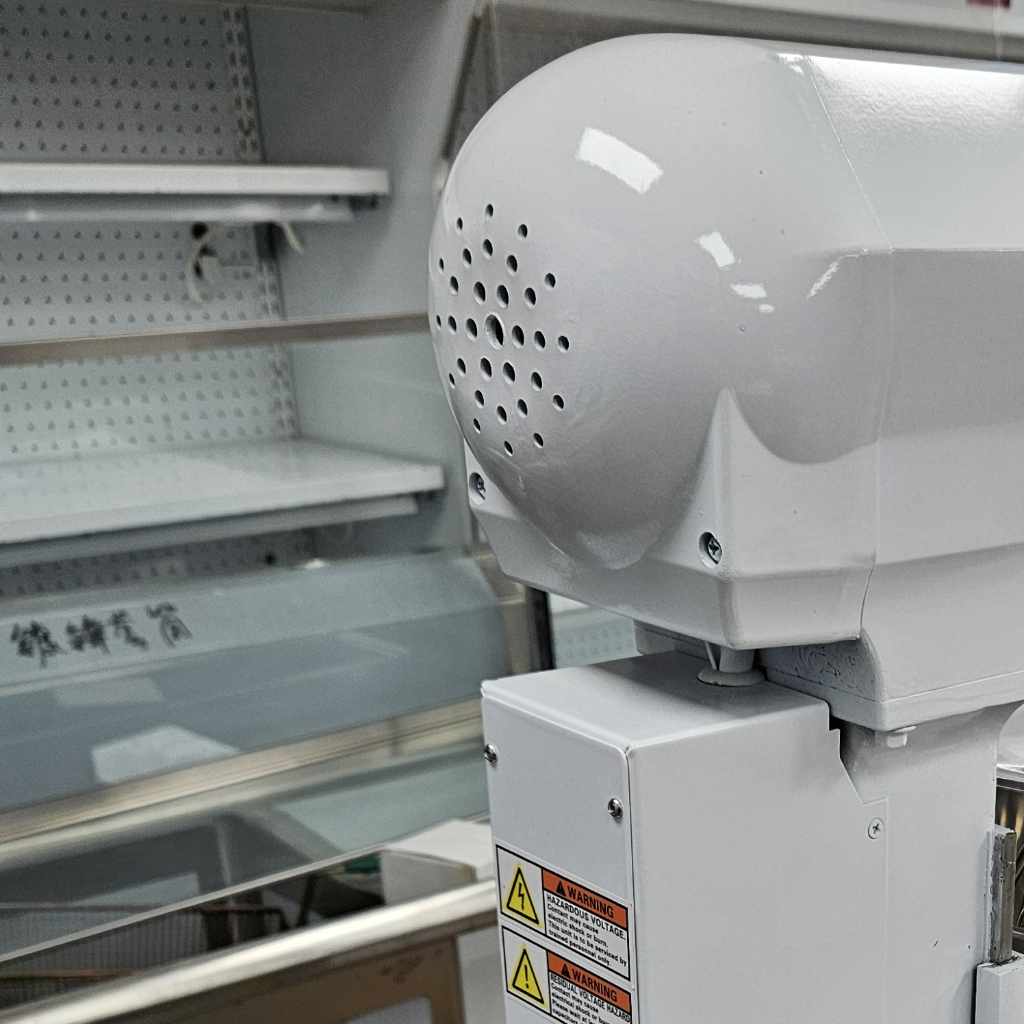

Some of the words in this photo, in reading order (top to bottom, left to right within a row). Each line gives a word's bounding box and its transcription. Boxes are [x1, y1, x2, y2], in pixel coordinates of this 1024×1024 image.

[546, 893, 589, 921] HAZARDOUS
[567, 884, 614, 918] WARNING
[571, 967, 618, 1003] WARNING
